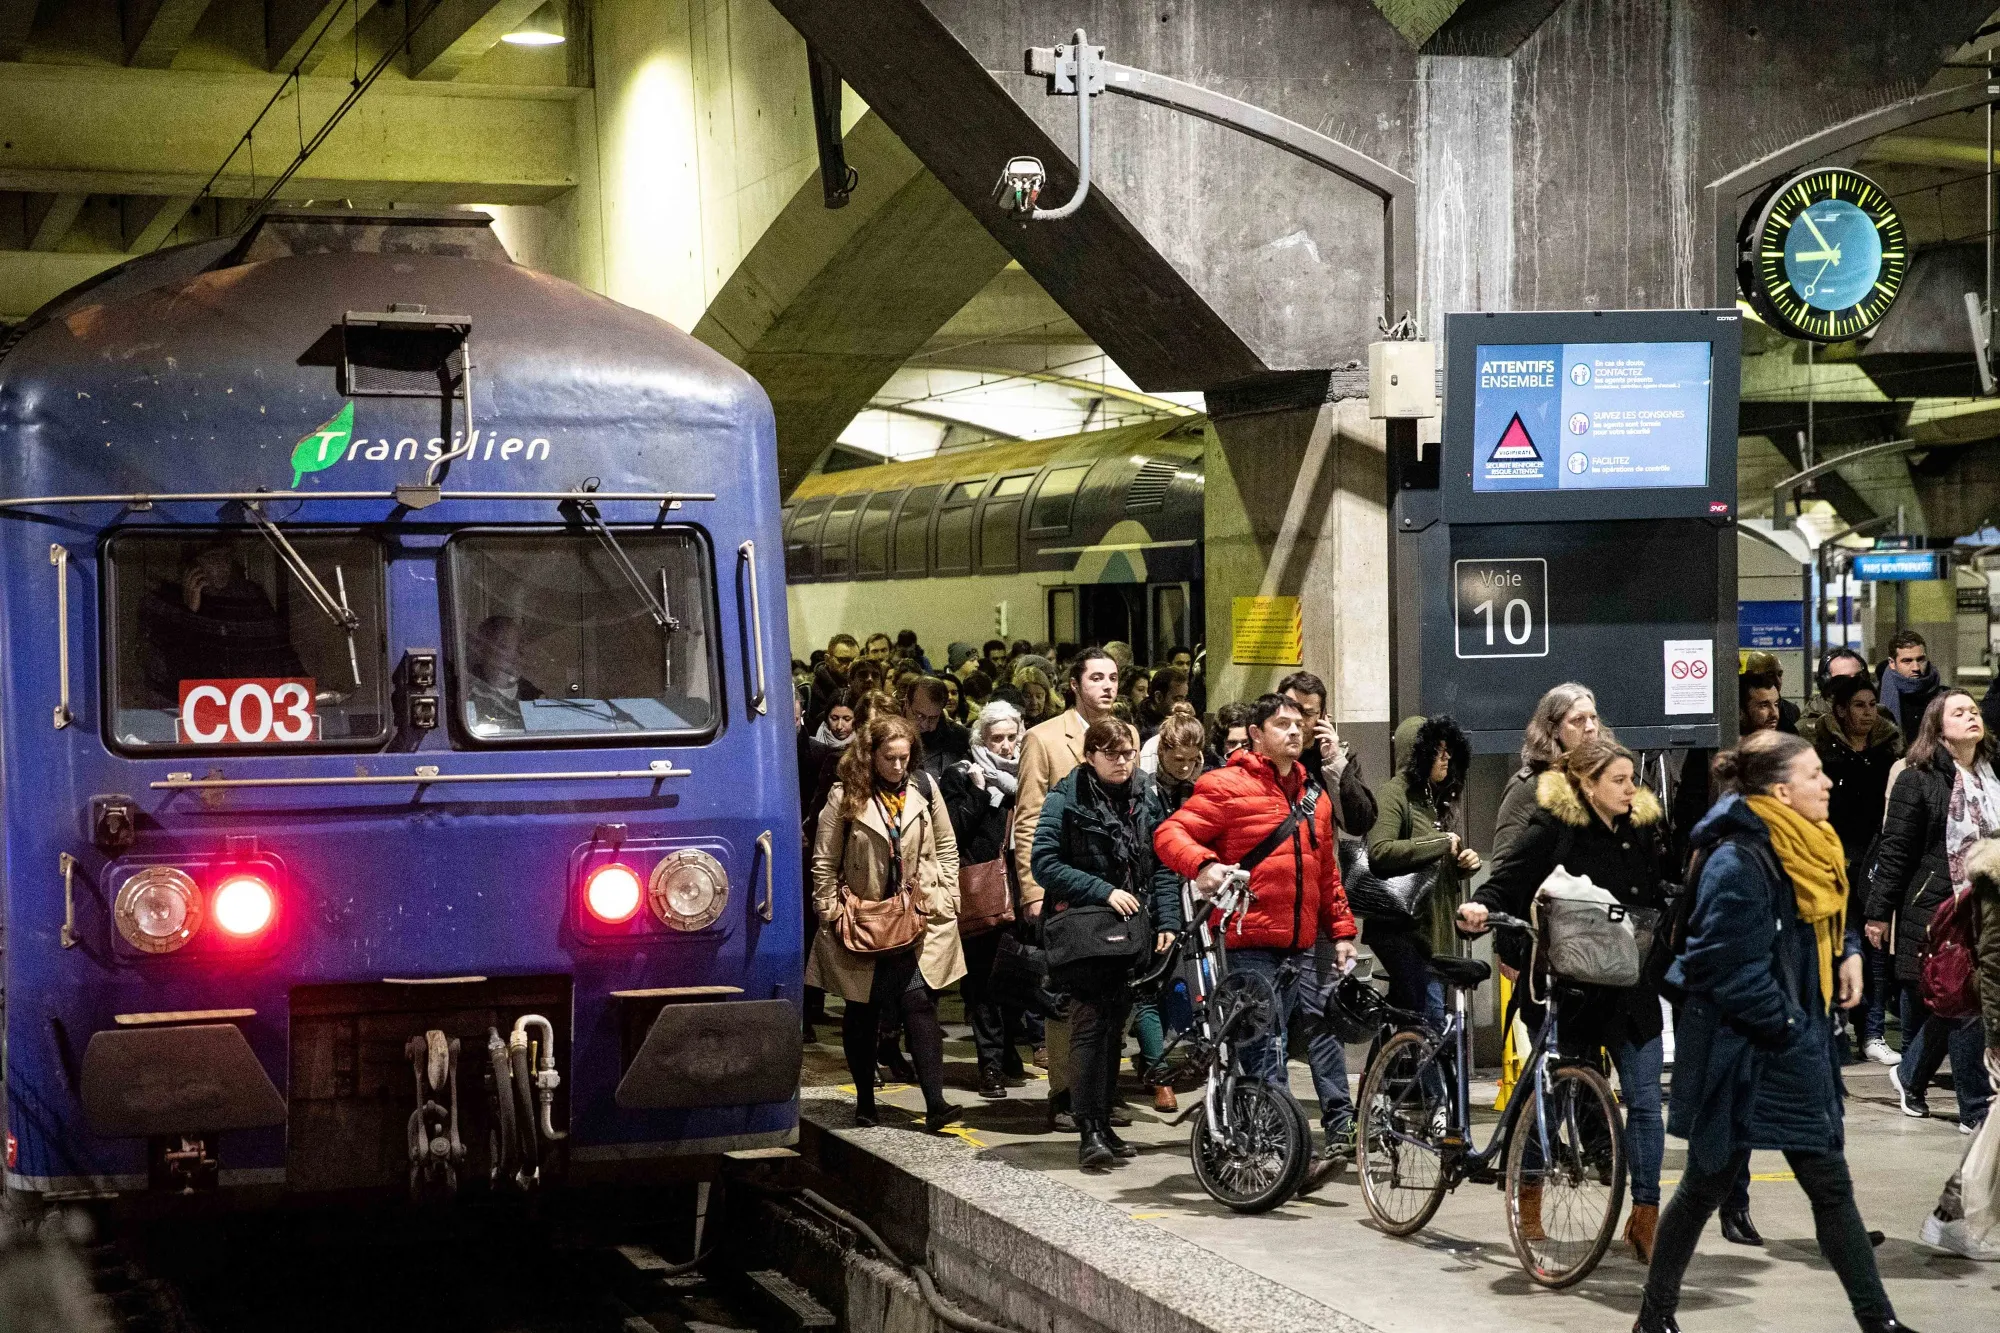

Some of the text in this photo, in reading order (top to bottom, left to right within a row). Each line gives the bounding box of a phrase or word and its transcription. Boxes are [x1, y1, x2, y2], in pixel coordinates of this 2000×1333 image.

[1481, 360, 1555, 374] ATTENTIFS
[1594, 368, 1643, 377] CONTACTEZ
[1481, 375, 1555, 388] ENSEMBLE
[1593, 410, 1685, 420] SUIVEZ LES CONSIGNES
[315, 429, 552, 462] Transilien
[1592, 457, 1630, 465] FACILITEZ
[1480, 569, 1522, 588] Voie
[1473, 598, 1532, 646] 10
